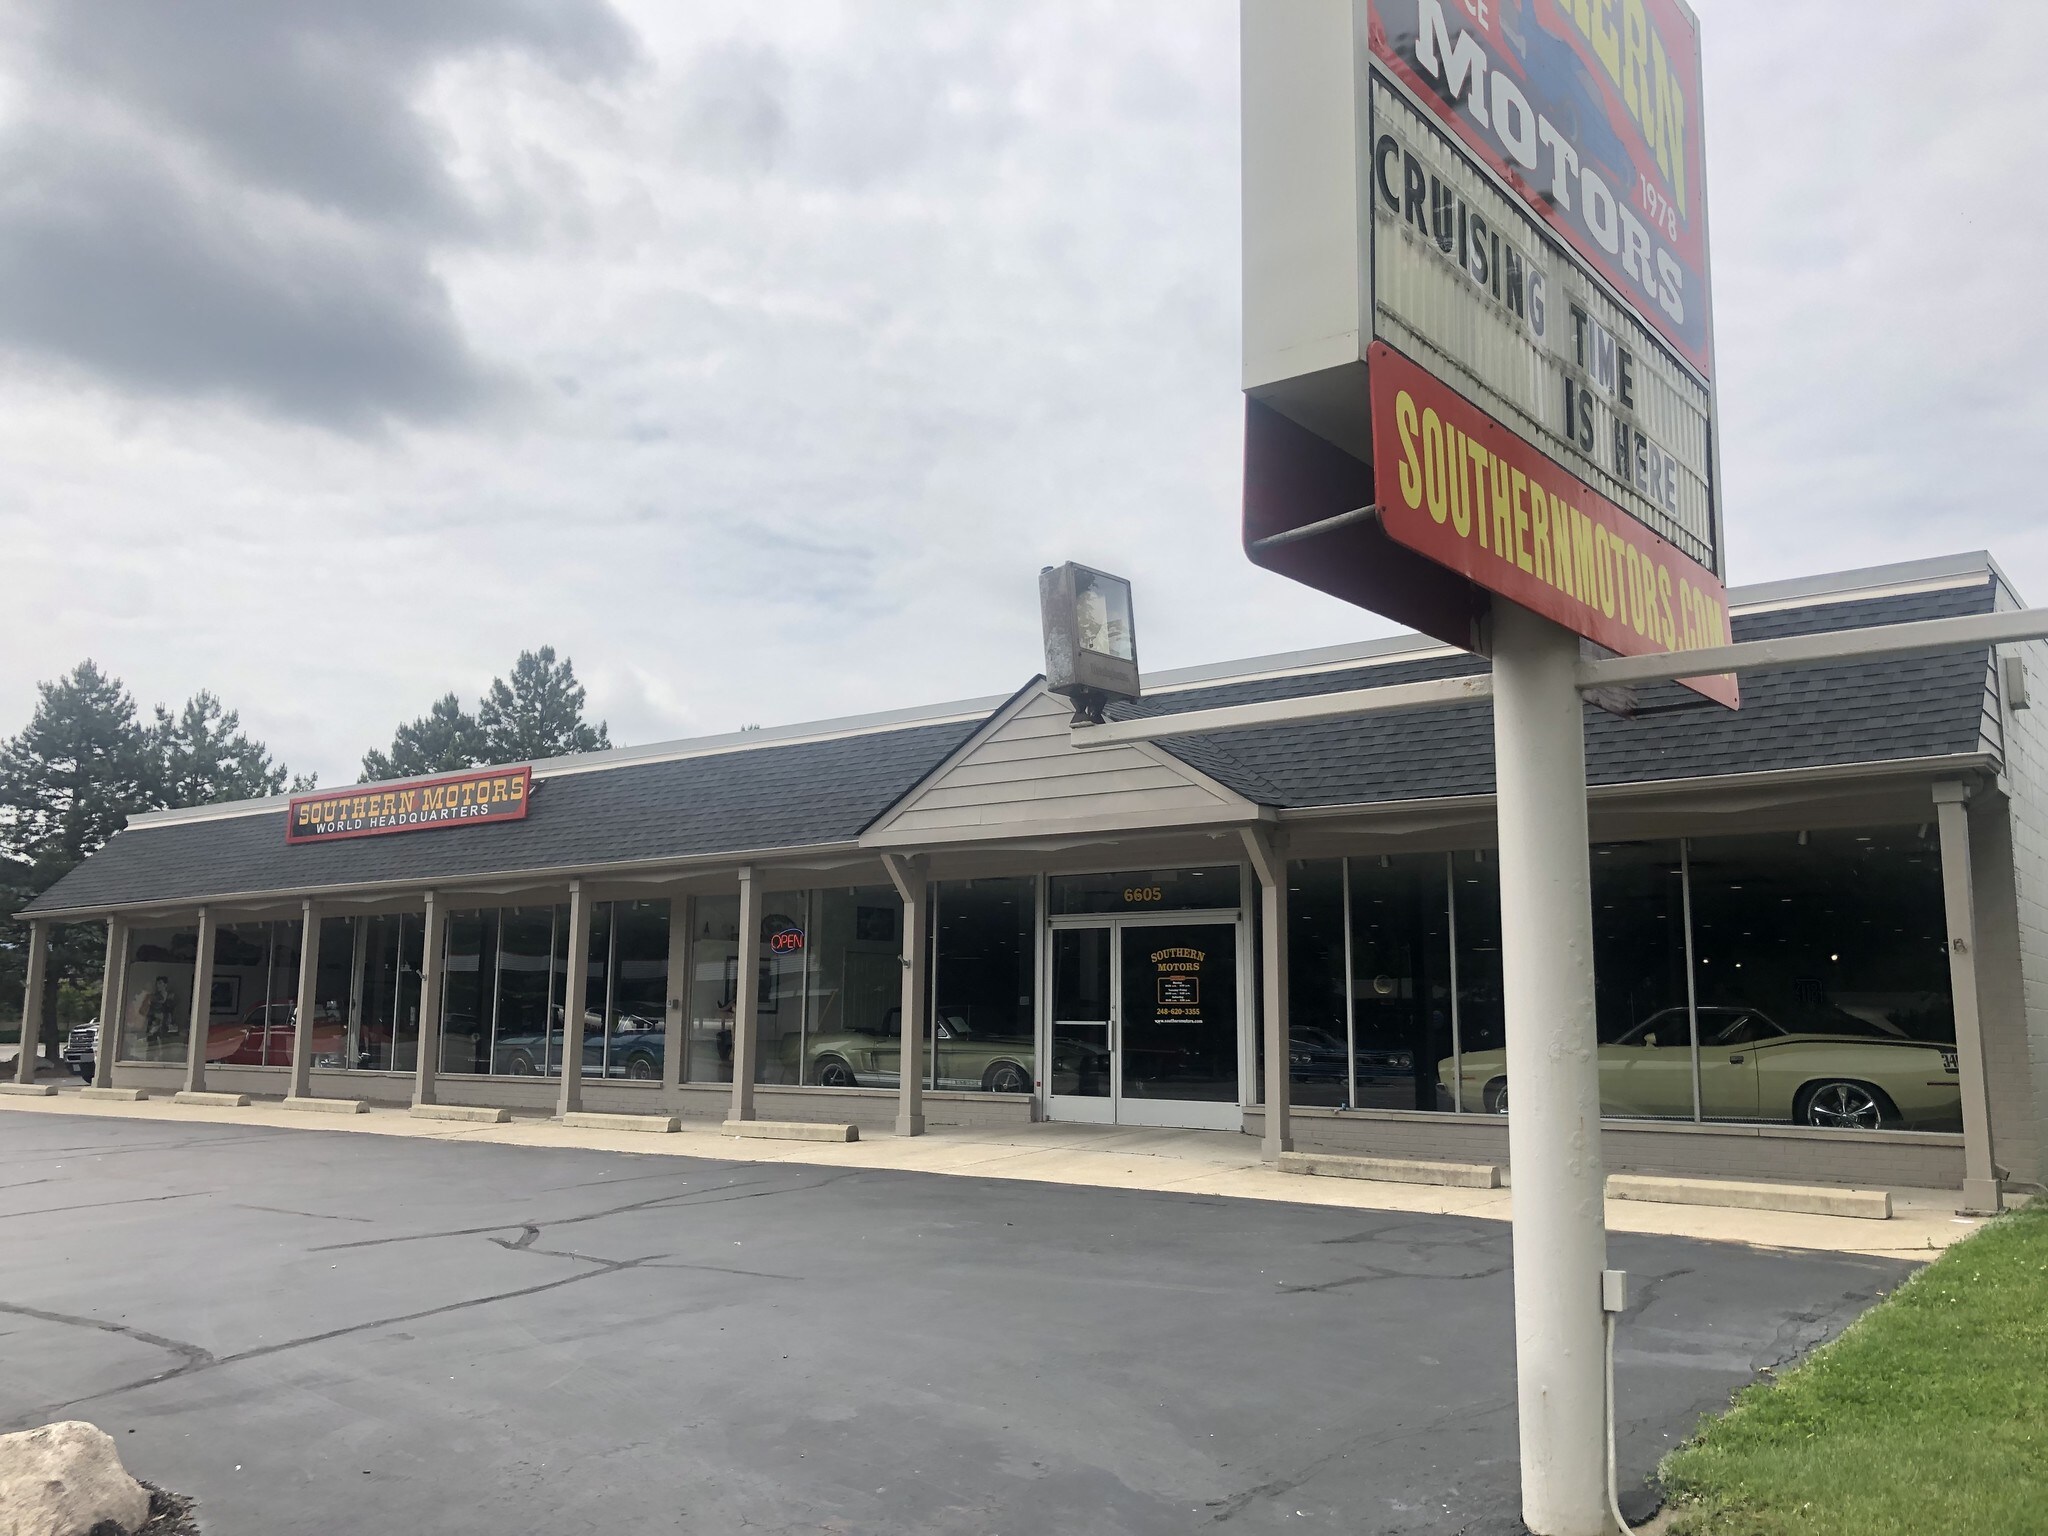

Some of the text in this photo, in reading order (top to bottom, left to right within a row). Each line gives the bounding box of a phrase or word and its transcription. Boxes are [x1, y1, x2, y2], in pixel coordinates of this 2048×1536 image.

[1415, 0, 1685, 325] MOTORS
[1640, 173, 1678, 242] 1978
[1375, 134, 1633, 410] CRUISING TIME
[1565, 377, 1676, 514] IS HERE
[1395, 390, 1730, 680] SOUTHERNMOTORS.COM
[298, 776, 525, 825] SOUTHERN MOTORS
[316, 803, 490, 834] WORLD HEADQUARTERS
[1123, 887, 1162, 902] 6605
[771, 934, 804, 949] OPEN
[1150, 947, 1206, 962] SOUTHERN
[1157, 962, 1200, 971] MOTORS
[1941, 1054, 1959, 1068] 34
